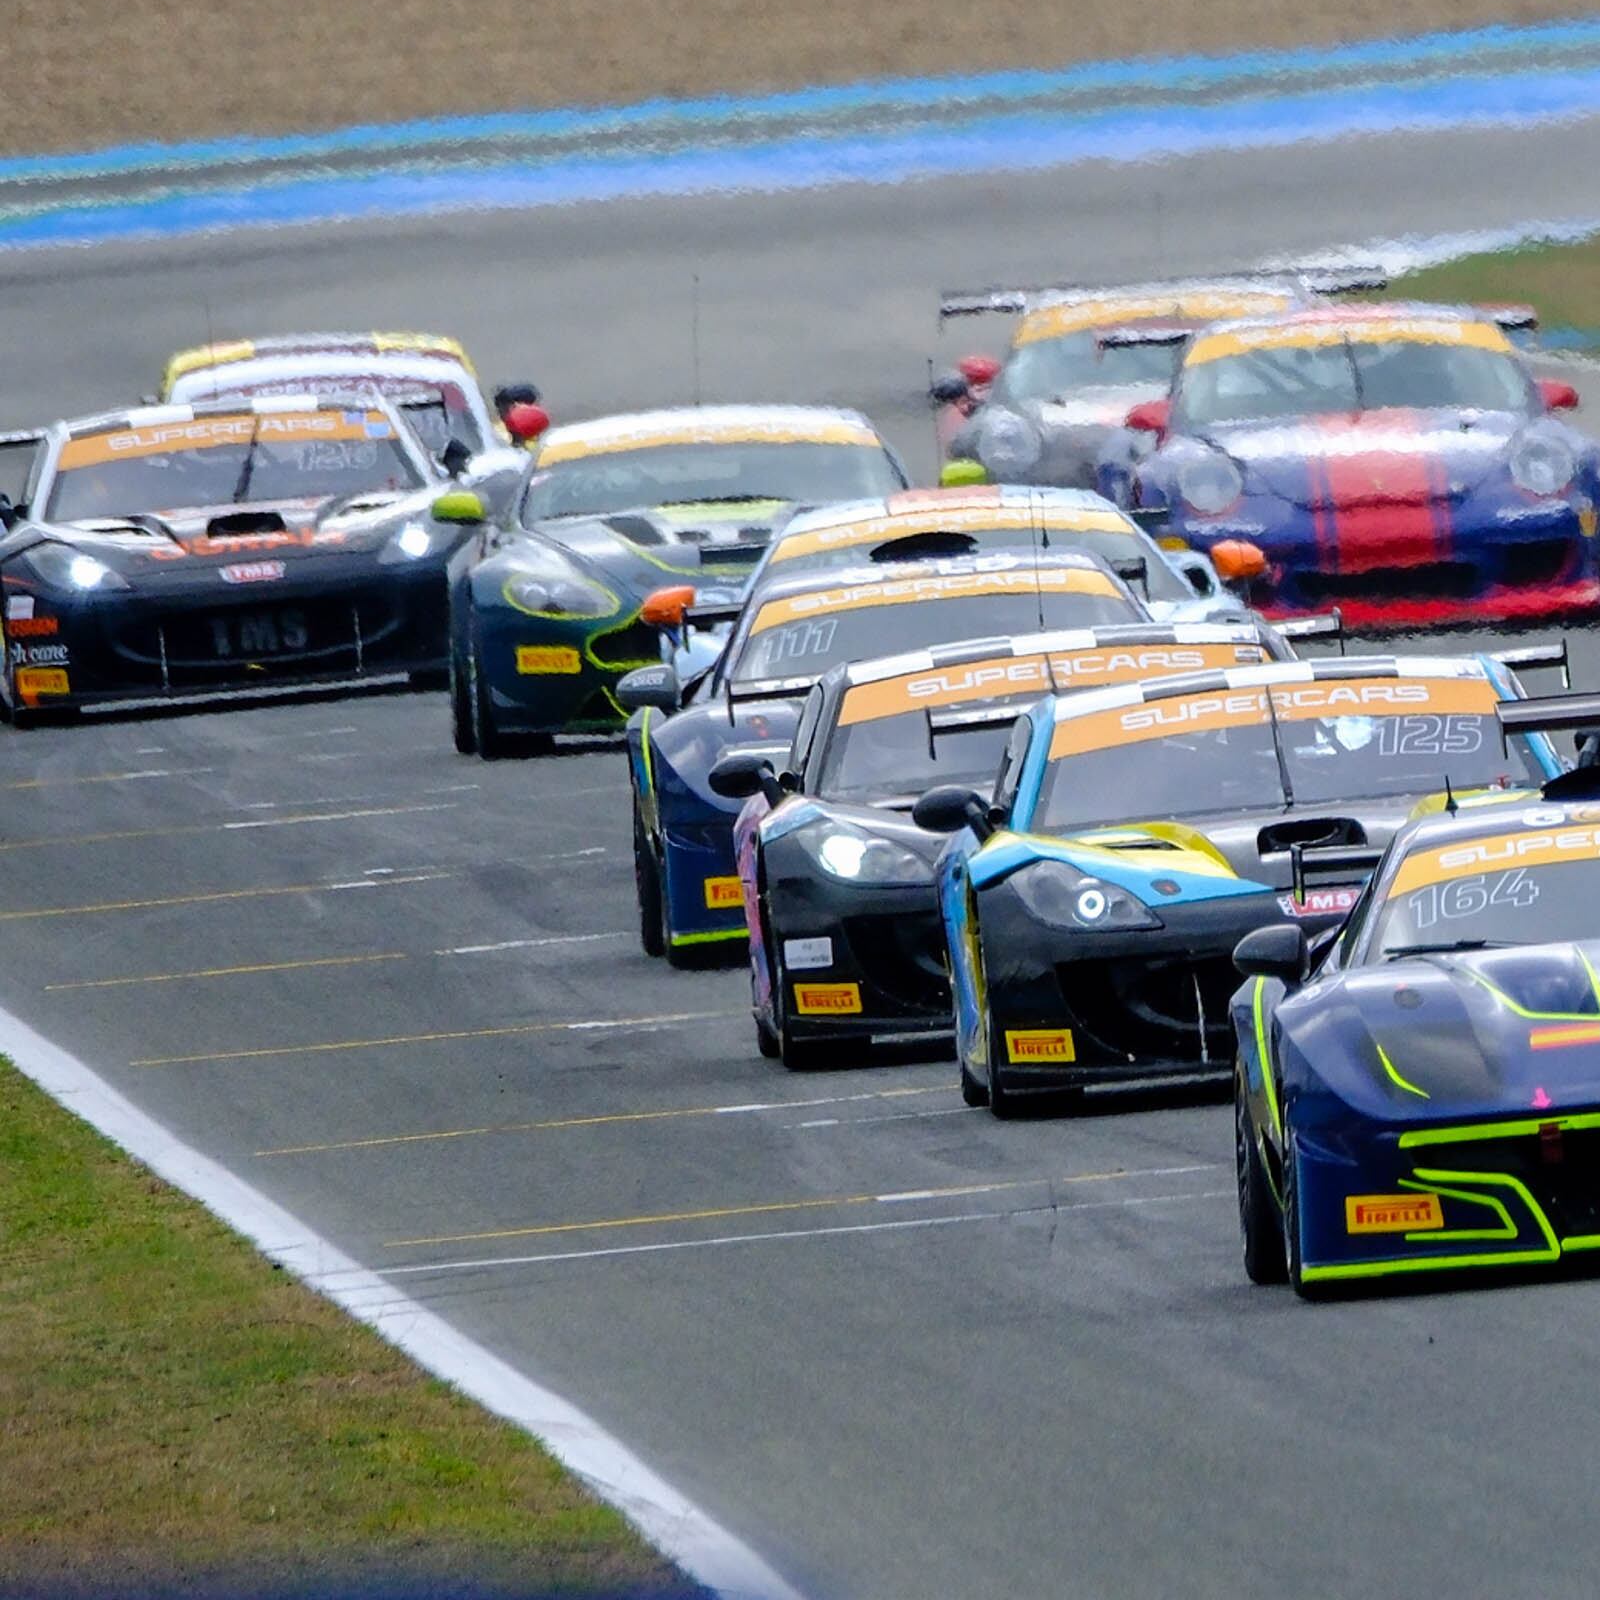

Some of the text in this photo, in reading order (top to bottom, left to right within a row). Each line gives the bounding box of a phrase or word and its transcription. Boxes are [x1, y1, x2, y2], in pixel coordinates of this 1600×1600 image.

[108, 416, 337, 449] SUPERCARS
[790, 569, 1067, 613] SUPERCARS
[764, 618, 838, 666] 111
[907, 650, 1204, 698] SUPERCARS
[1120, 685, 1430, 731] SUPERCARS
[1374, 715, 1483, 756] 125
[1408, 868, 1539, 928] 164
[802, 990, 854, 1008] PIRELLI
[1013, 1036, 1066, 1056] PIRELLI
[1356, 1201, 1433, 1225] PIRELLI
